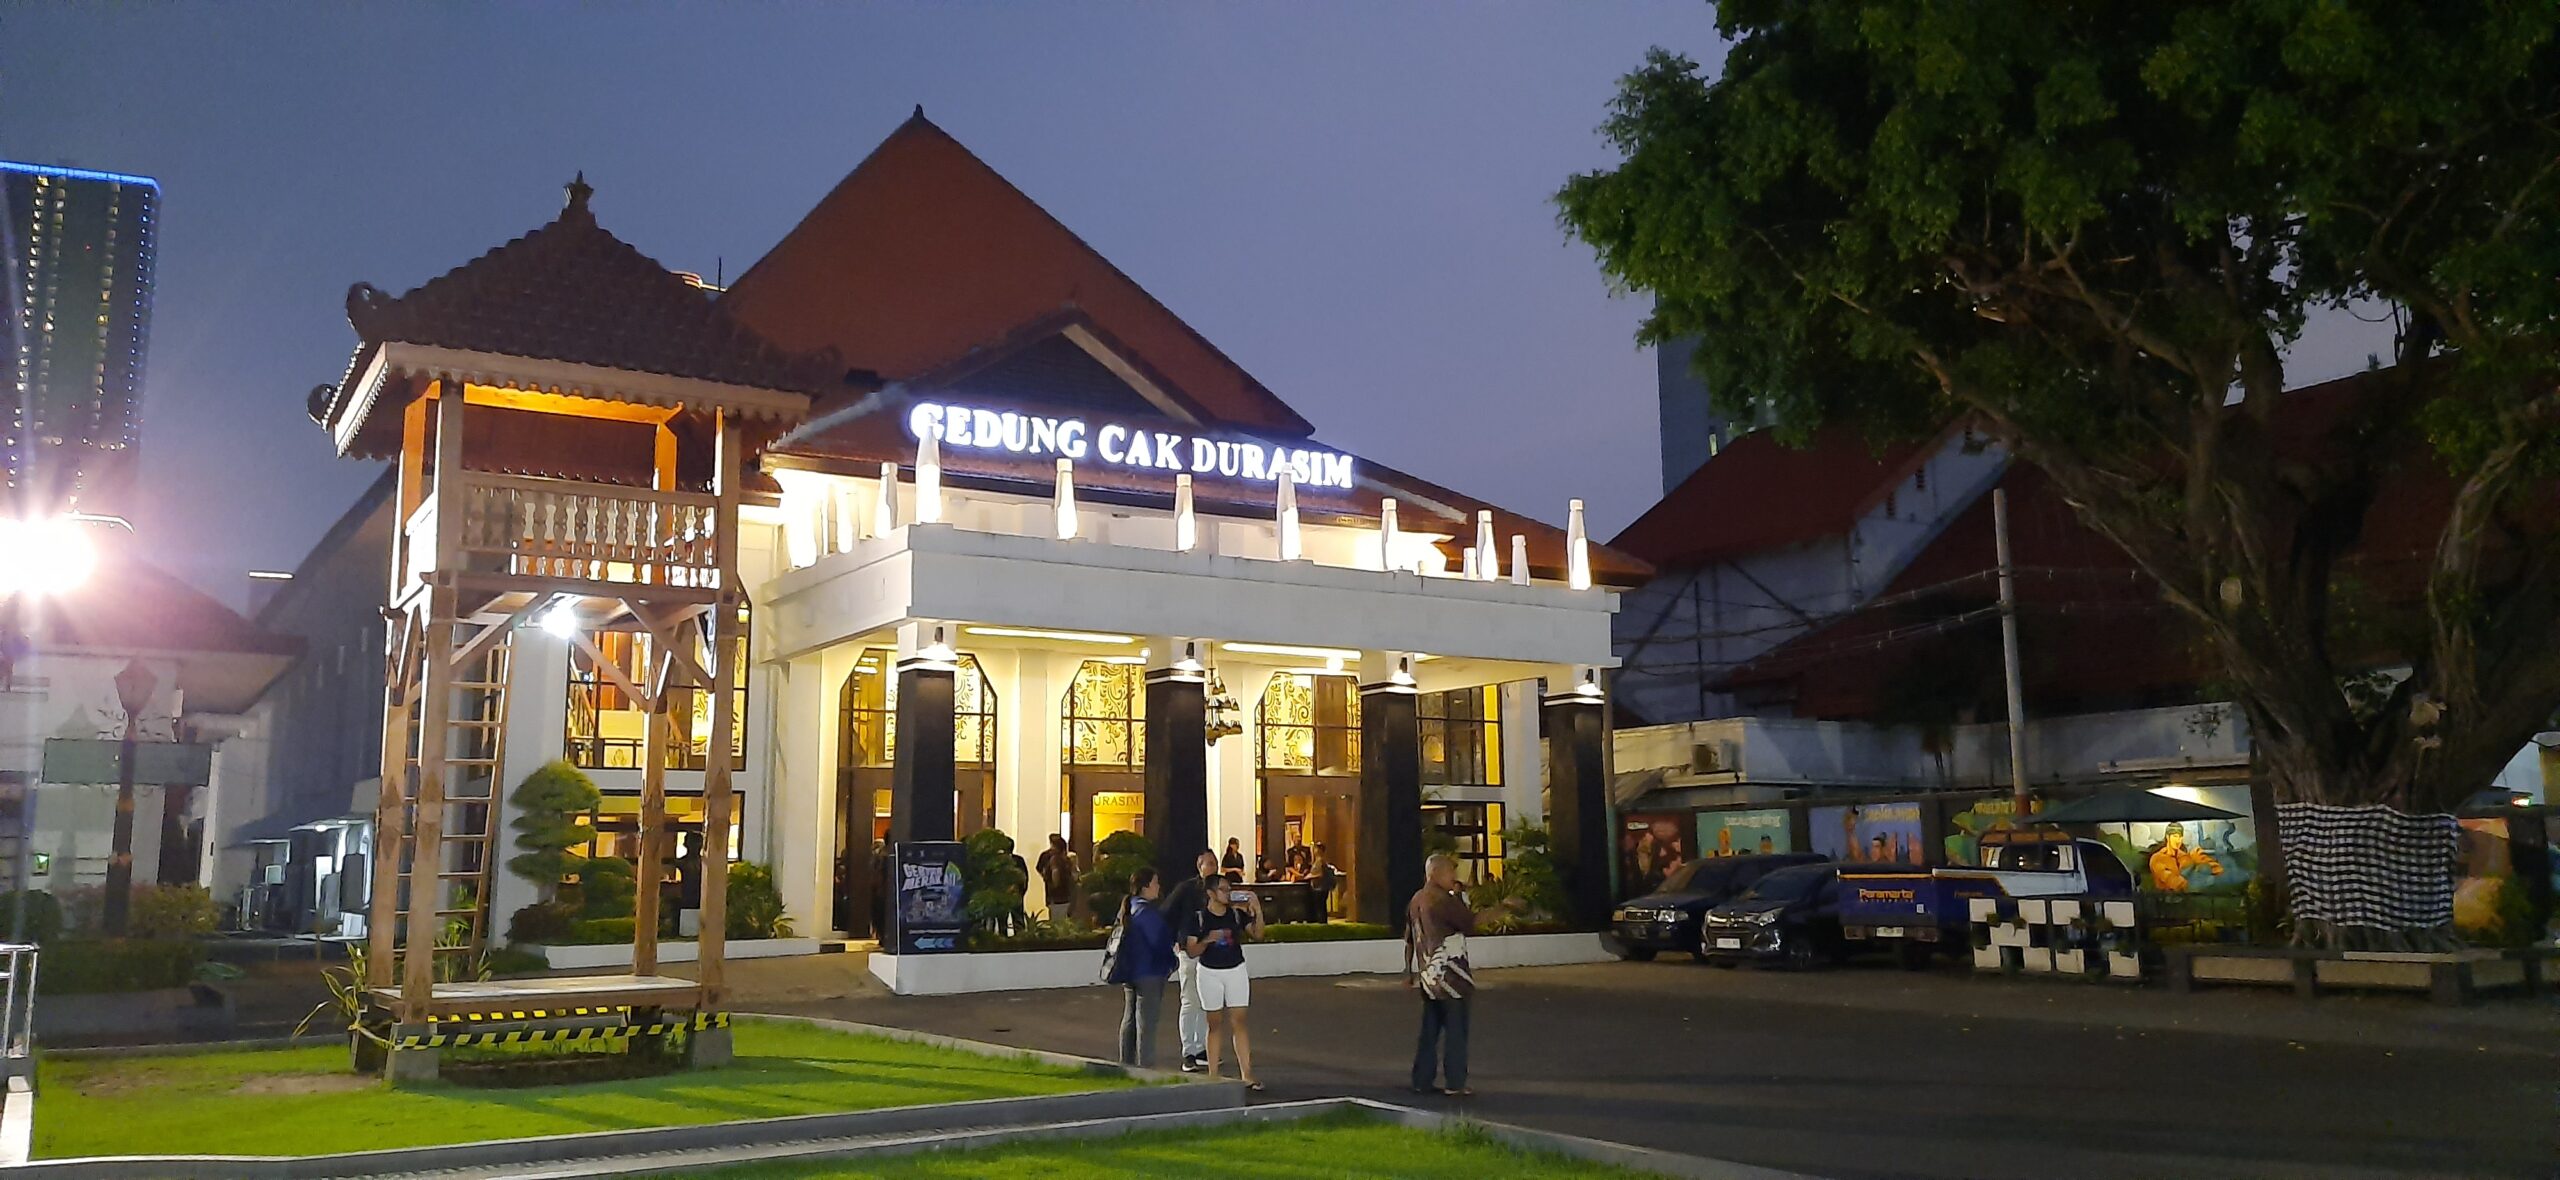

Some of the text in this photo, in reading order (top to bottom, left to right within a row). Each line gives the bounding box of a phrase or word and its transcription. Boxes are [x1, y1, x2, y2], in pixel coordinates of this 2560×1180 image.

[911, 403, 1353, 488] GEDUNG CAK DURASIM
